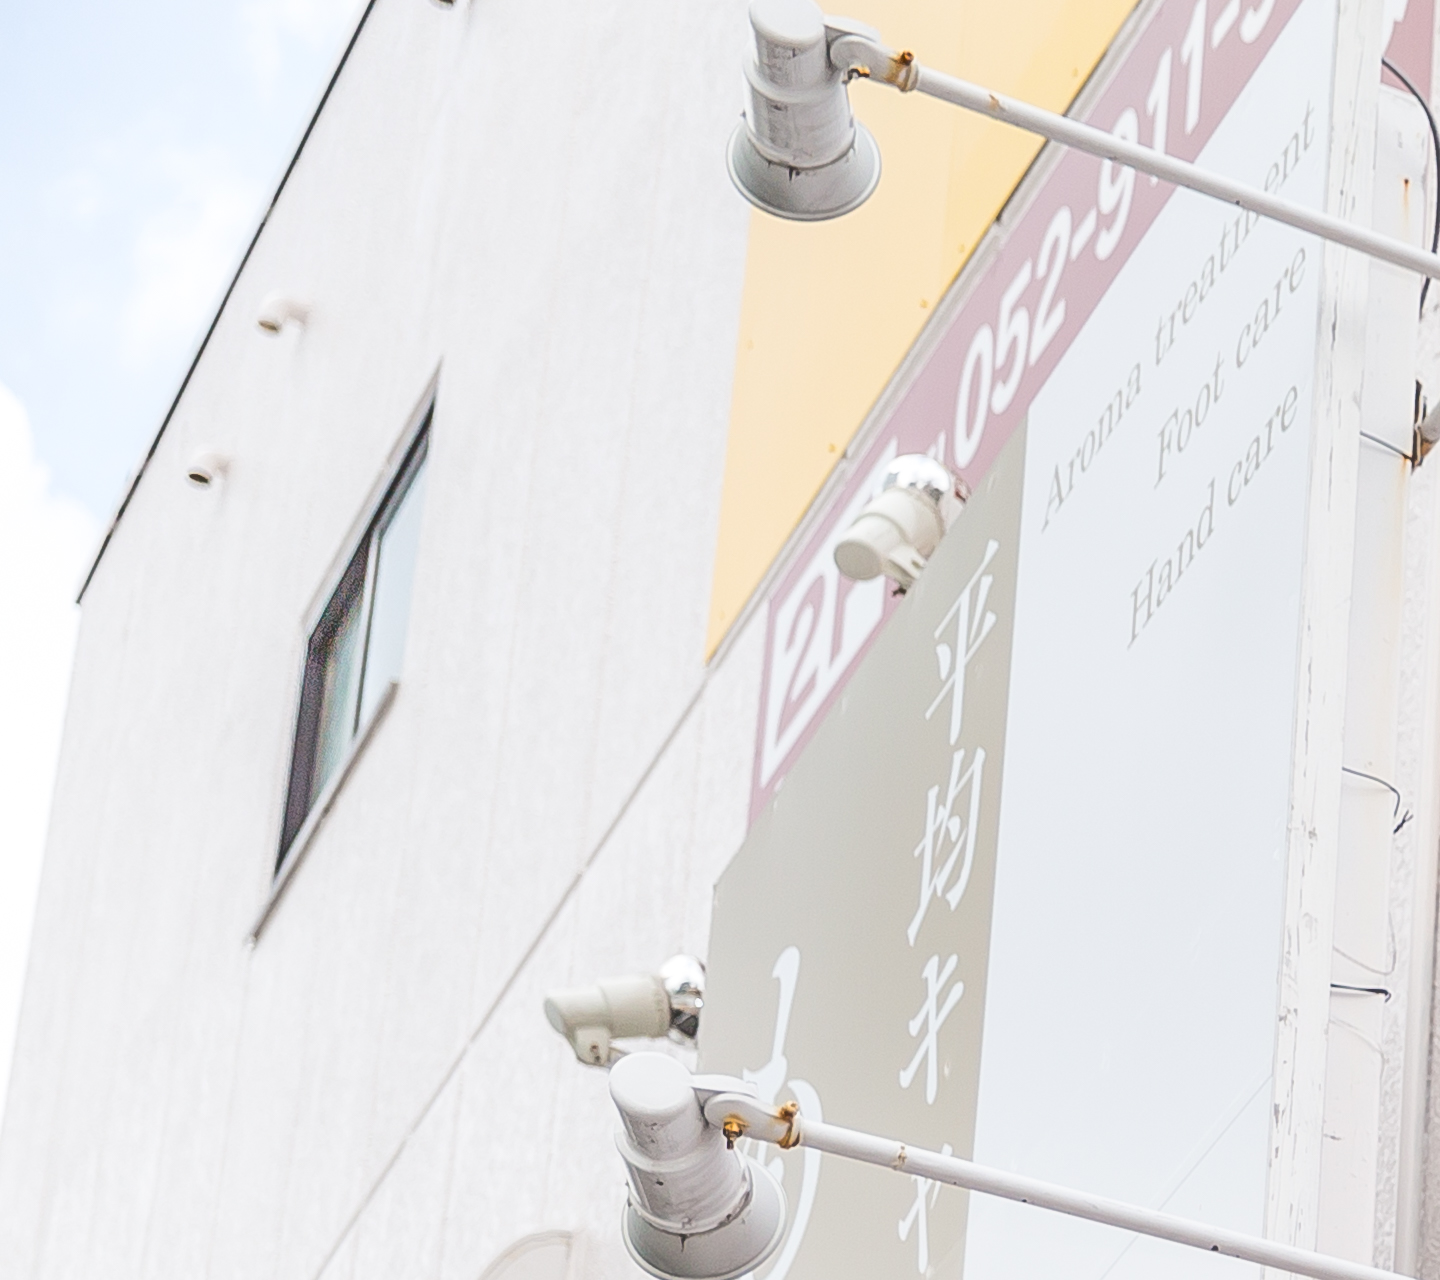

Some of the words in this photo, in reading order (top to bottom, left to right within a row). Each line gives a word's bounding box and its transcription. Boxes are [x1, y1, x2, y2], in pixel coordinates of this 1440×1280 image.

[955, 0, 1278, 469] 052-911-
[1042, 360, 1143, 533] Aroma
[1153, 350, 1226, 488] Foot
[1235, 247, 1307, 370] care
[1127, 475, 1217, 650] Hand
[1227, 384, 1300, 509] care
